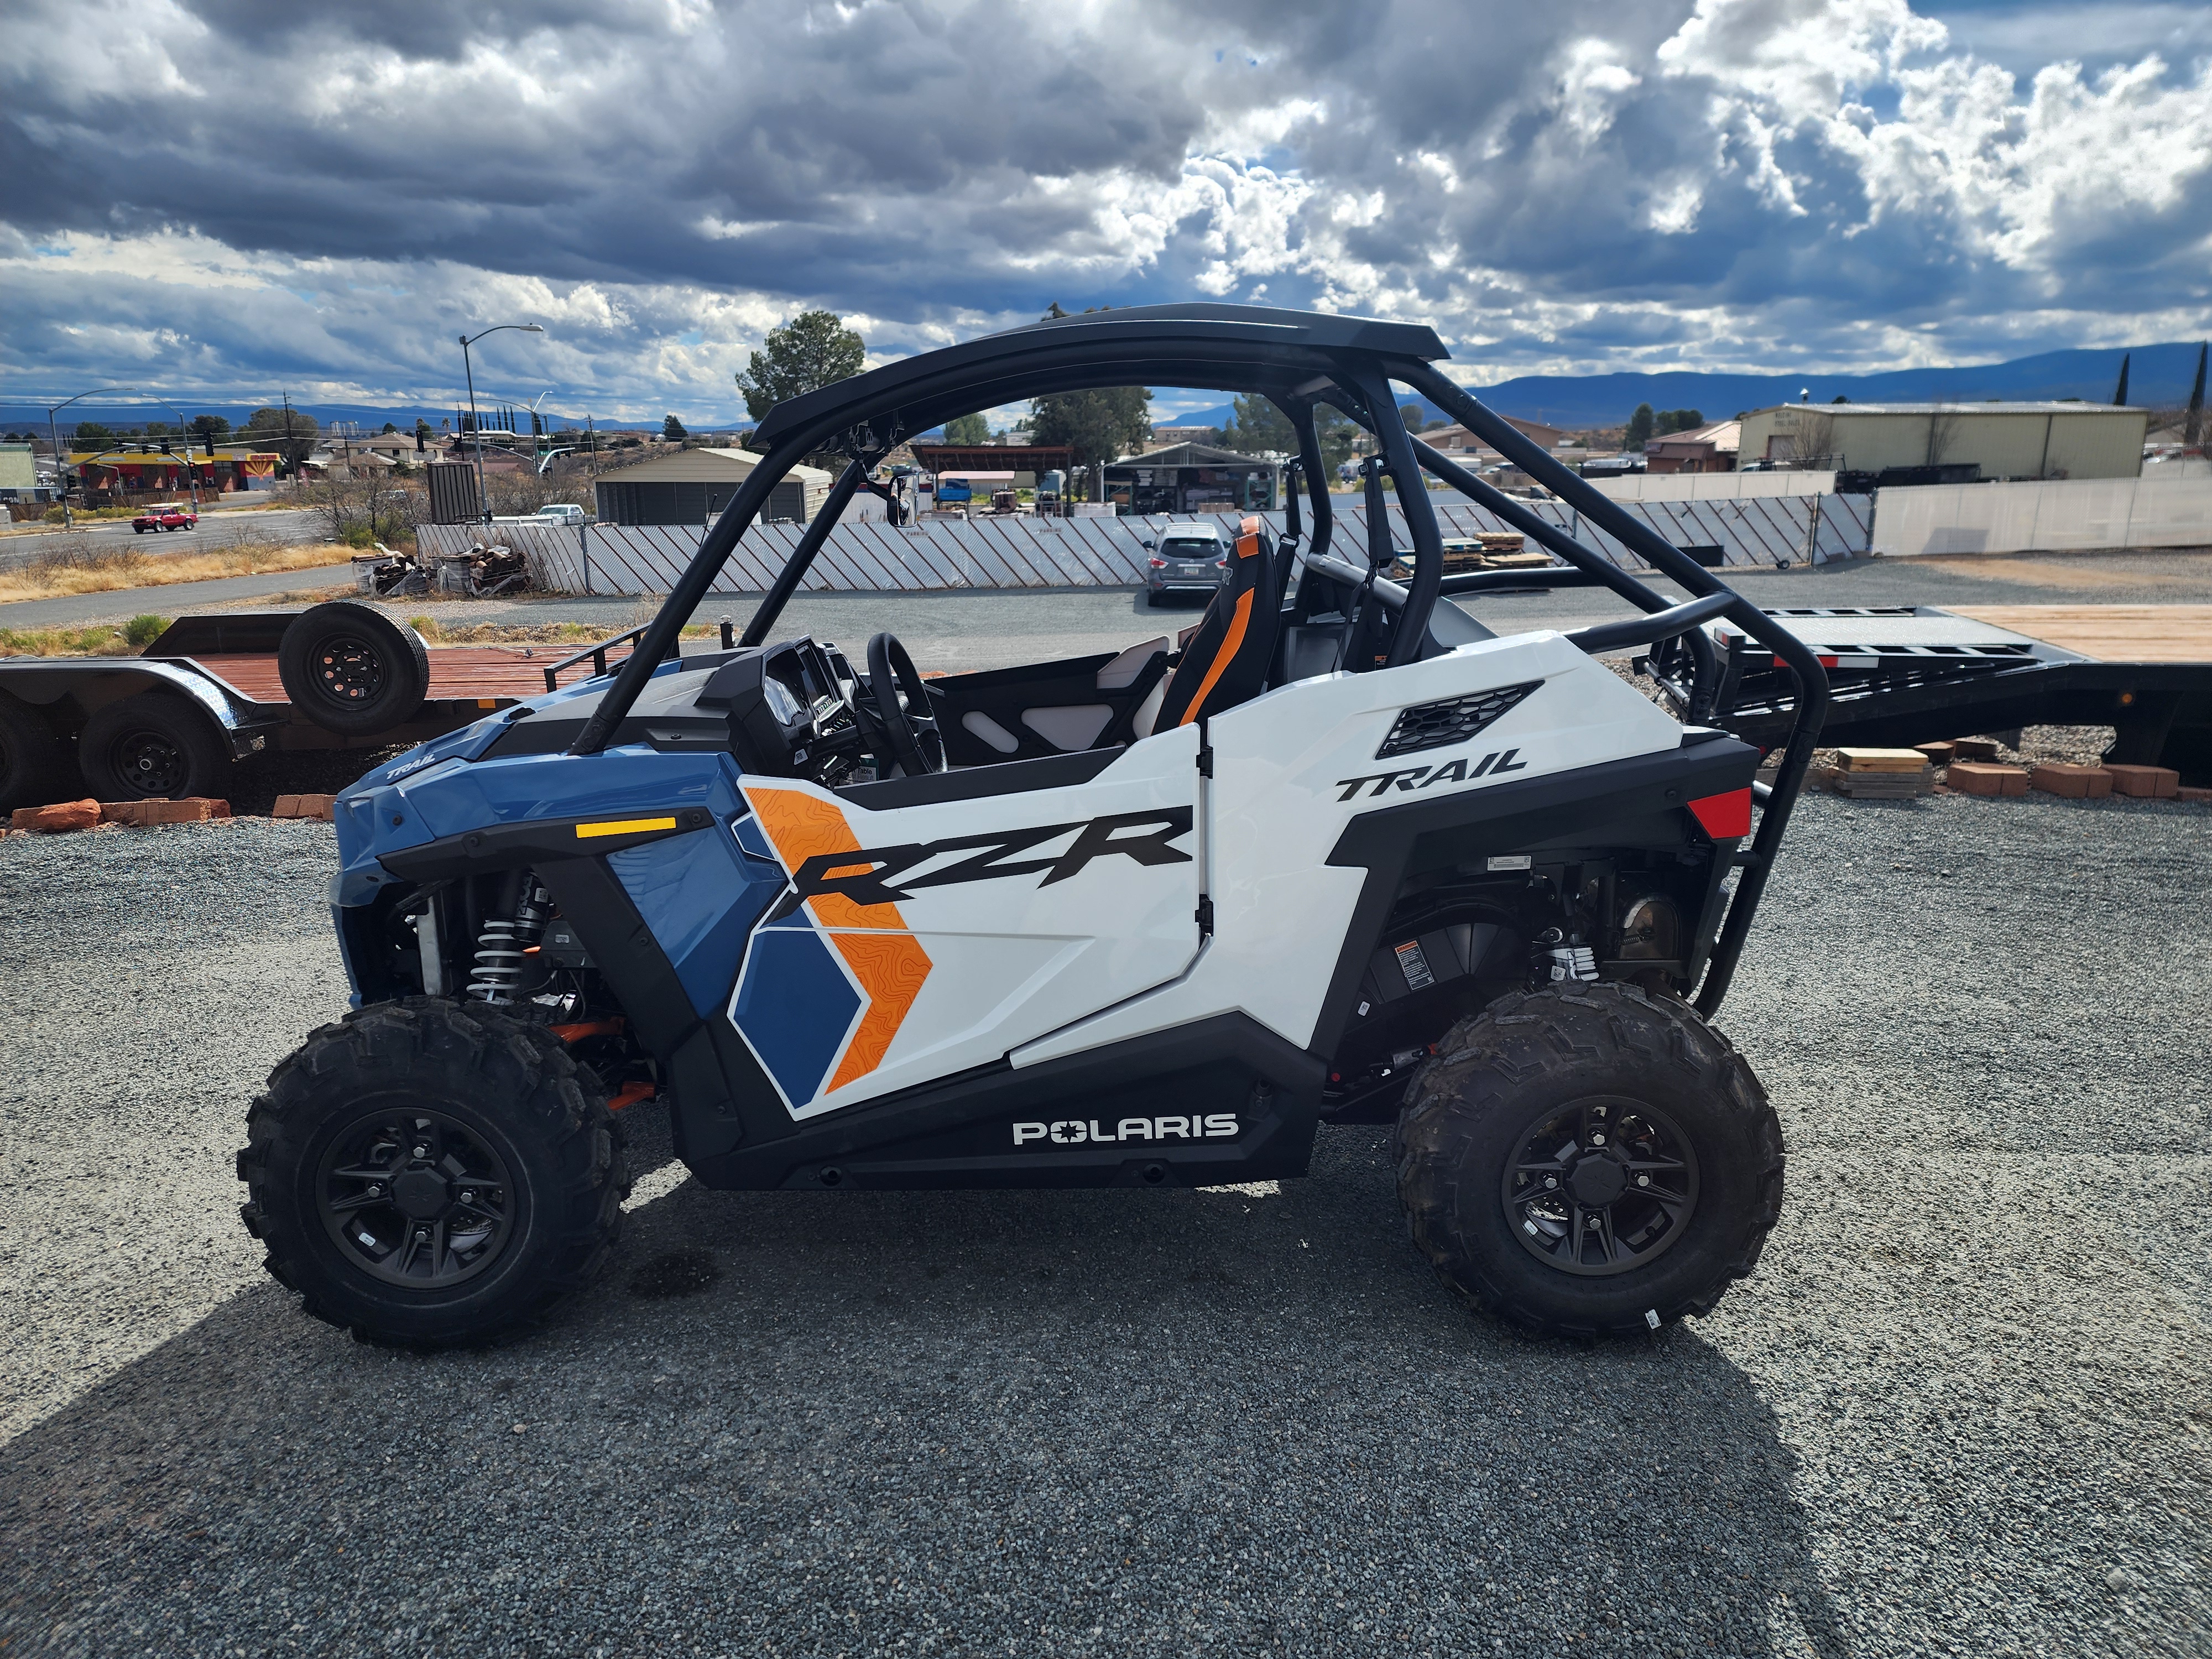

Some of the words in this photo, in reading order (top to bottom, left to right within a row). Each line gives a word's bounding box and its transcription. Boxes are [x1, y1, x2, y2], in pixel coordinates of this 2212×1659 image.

[386, 753, 436, 780] TRAIL
[1335, 748, 1528, 803] TRAIL
[763, 805, 1193, 924] RZR
[1013, 1113, 1239, 1145] POLARIS
